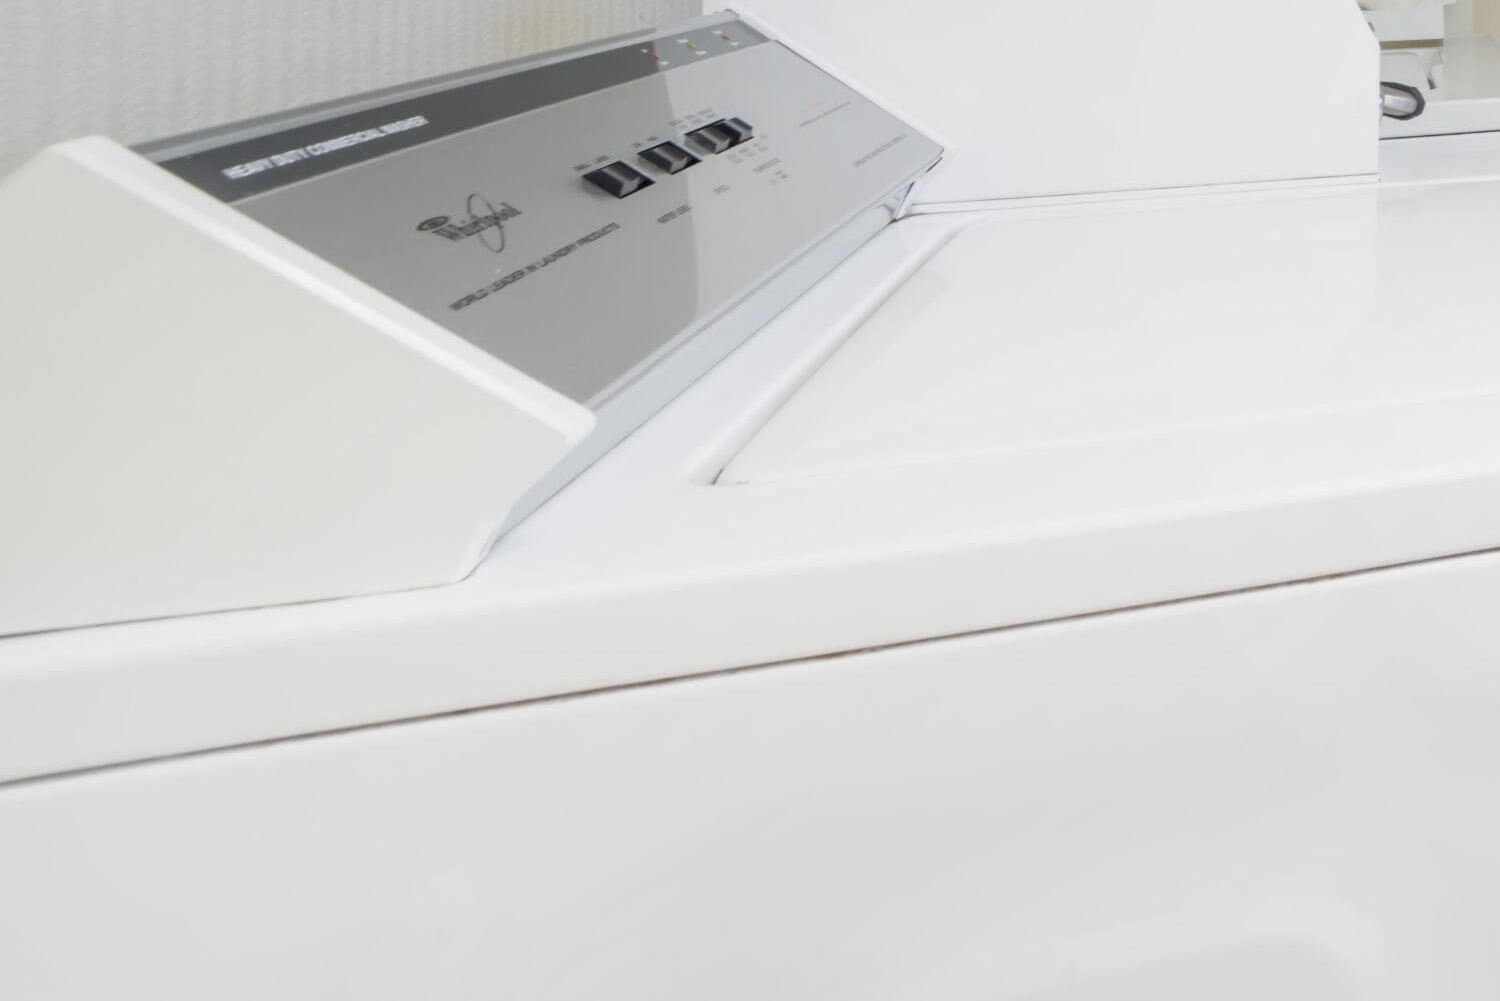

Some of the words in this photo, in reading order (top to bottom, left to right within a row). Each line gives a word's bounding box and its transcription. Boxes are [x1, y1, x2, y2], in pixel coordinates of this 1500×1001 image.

[222, 158, 275, 180] HEAVY
[269, 148, 310, 167] DUTY
[304, 127, 387, 156] COMMERCIAL
[448, 288, 488, 311] WORLD
[490, 269, 525, 292] LEADER
